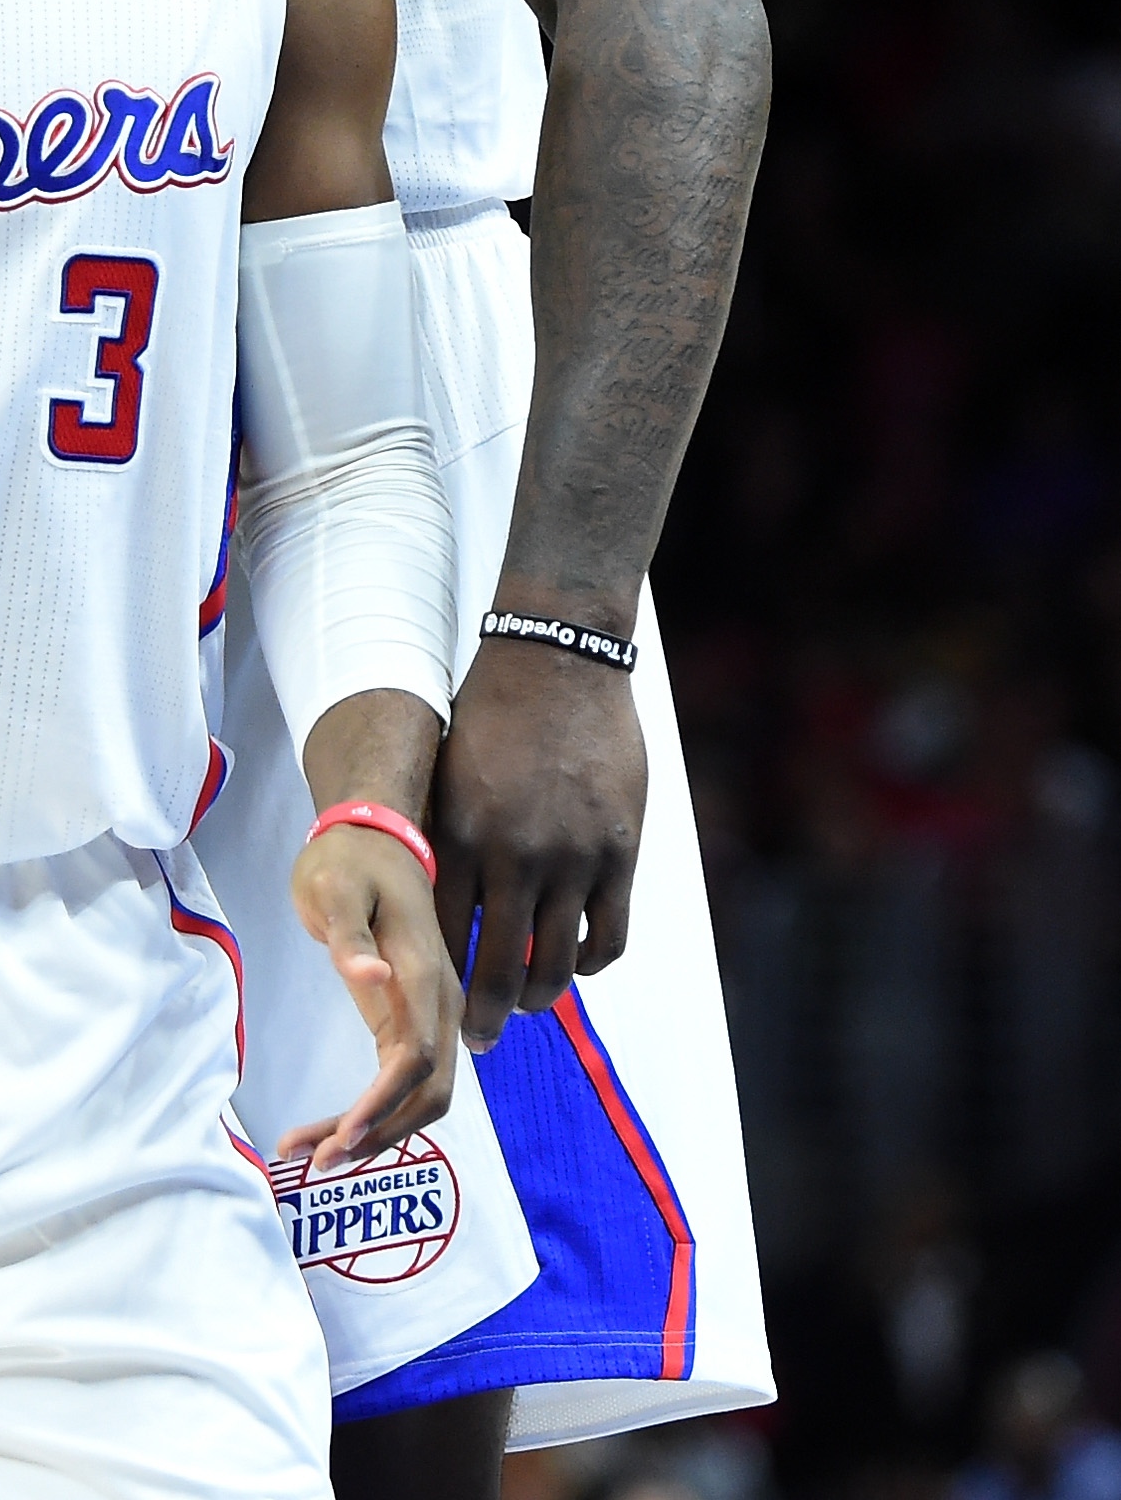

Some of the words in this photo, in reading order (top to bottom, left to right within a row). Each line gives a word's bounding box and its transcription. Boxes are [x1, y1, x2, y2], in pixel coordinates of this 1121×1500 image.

[45, 250, 163, 468] 3
[497, 613, 576, 646] Oyedeji
[579, 632, 621, 661] Tobi
[310, 1186, 345, 1208] LOS
[350, 1167, 439, 1199] ANGELES
[278, 1189, 444, 1258] IPPERS
